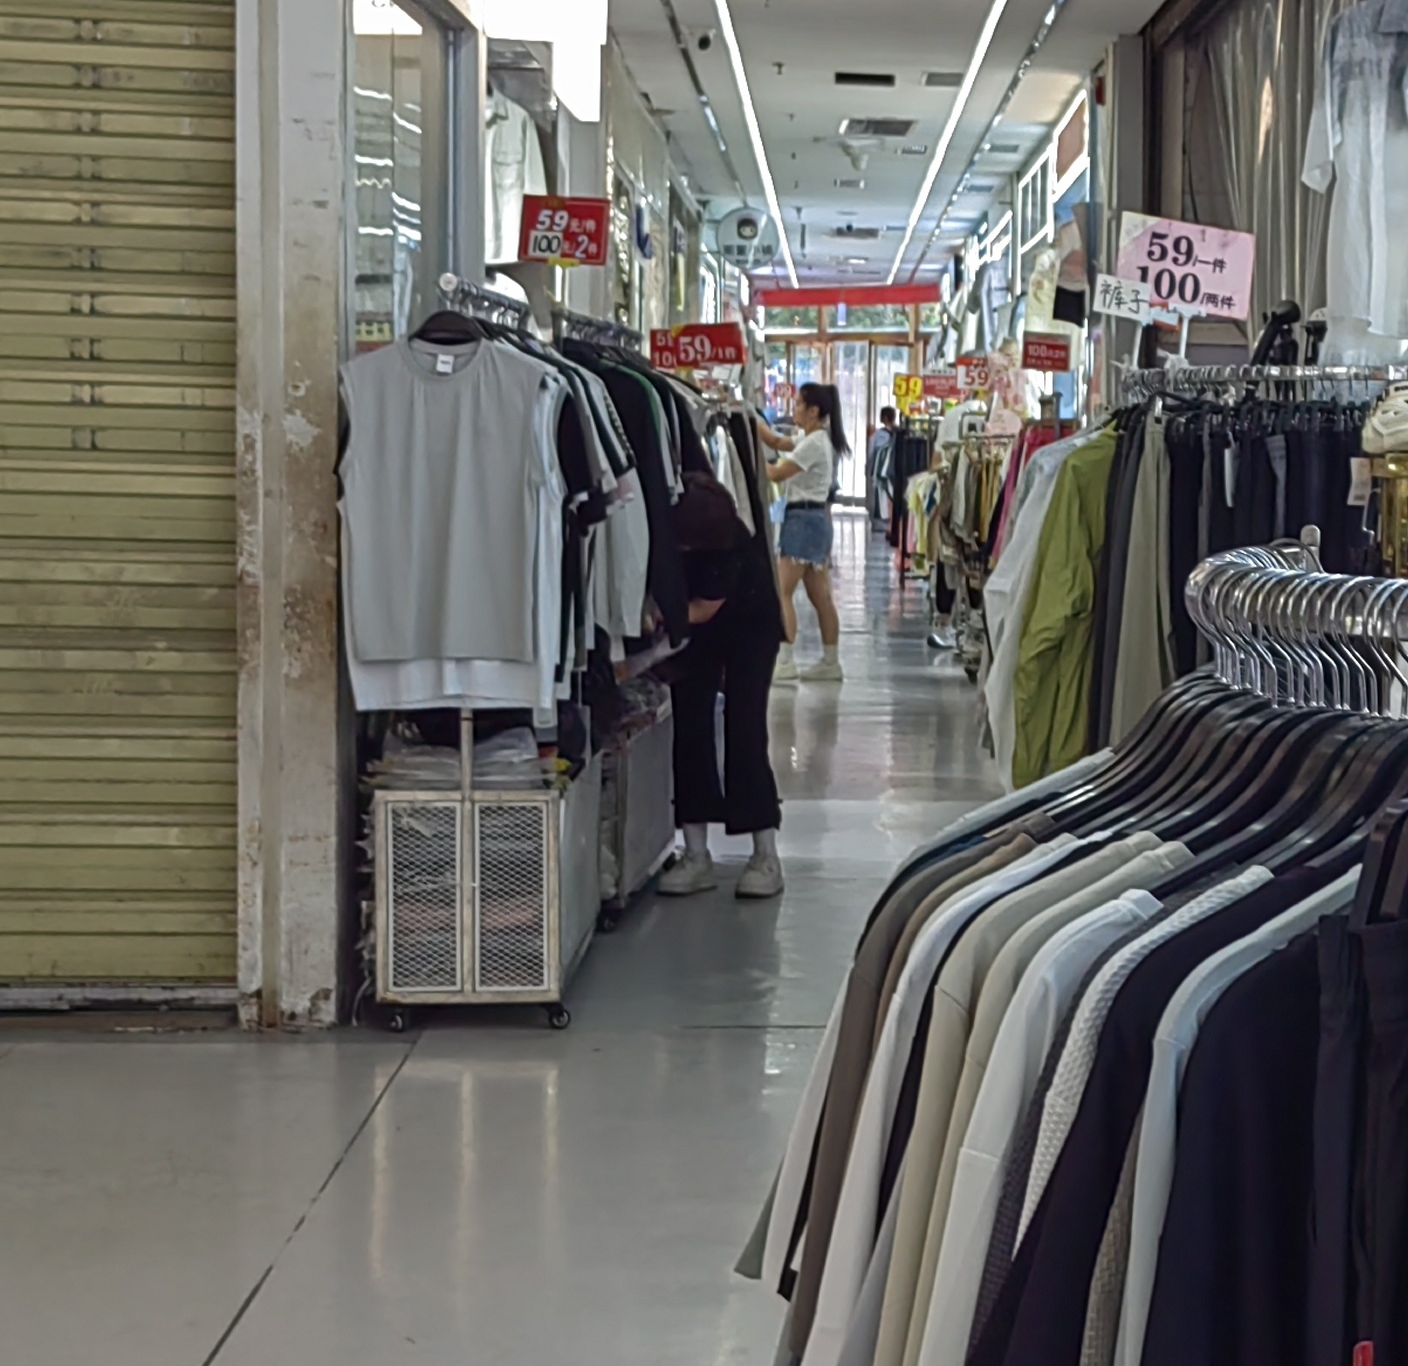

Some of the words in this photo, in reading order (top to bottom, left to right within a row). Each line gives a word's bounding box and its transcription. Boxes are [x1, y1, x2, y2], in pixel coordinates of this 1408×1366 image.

[1147, 231, 1227, 274] 59/一件
[1099, 280, 1150, 315] 裤子
[893, 374, 923, 400] 59
[964, 369, 990, 386] 59
